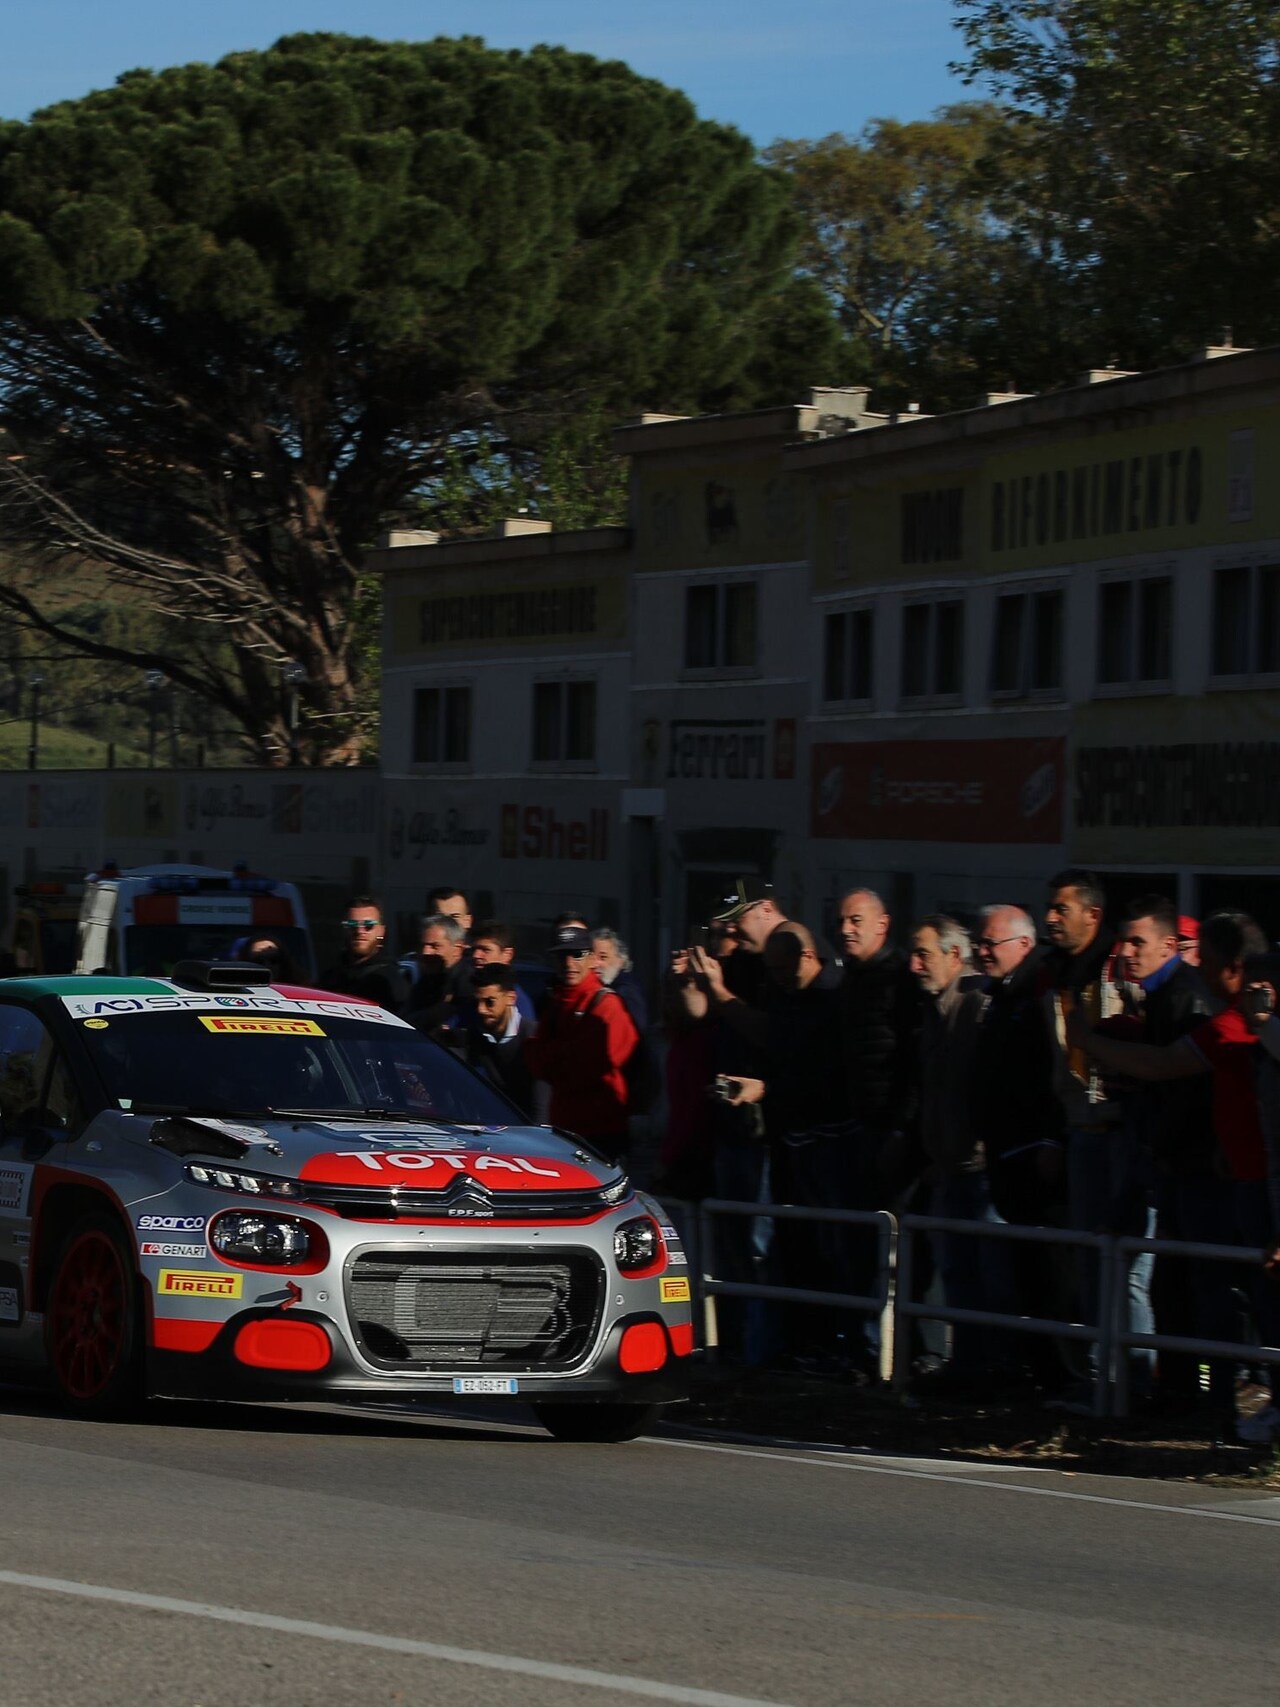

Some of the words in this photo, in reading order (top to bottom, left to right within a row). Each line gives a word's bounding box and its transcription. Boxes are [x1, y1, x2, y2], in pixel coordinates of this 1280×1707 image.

[668, 719, 765, 778] Ferrari
[523, 805, 608, 861] Shell
[211, 1019, 312, 1033] PIRELLI
[335, 1152, 561, 1178] TOTAL
[139, 1215, 204, 1230] sparco
[162, 1245, 206, 1257] GENART
[165, 1273, 235, 1294] PIRELLI
